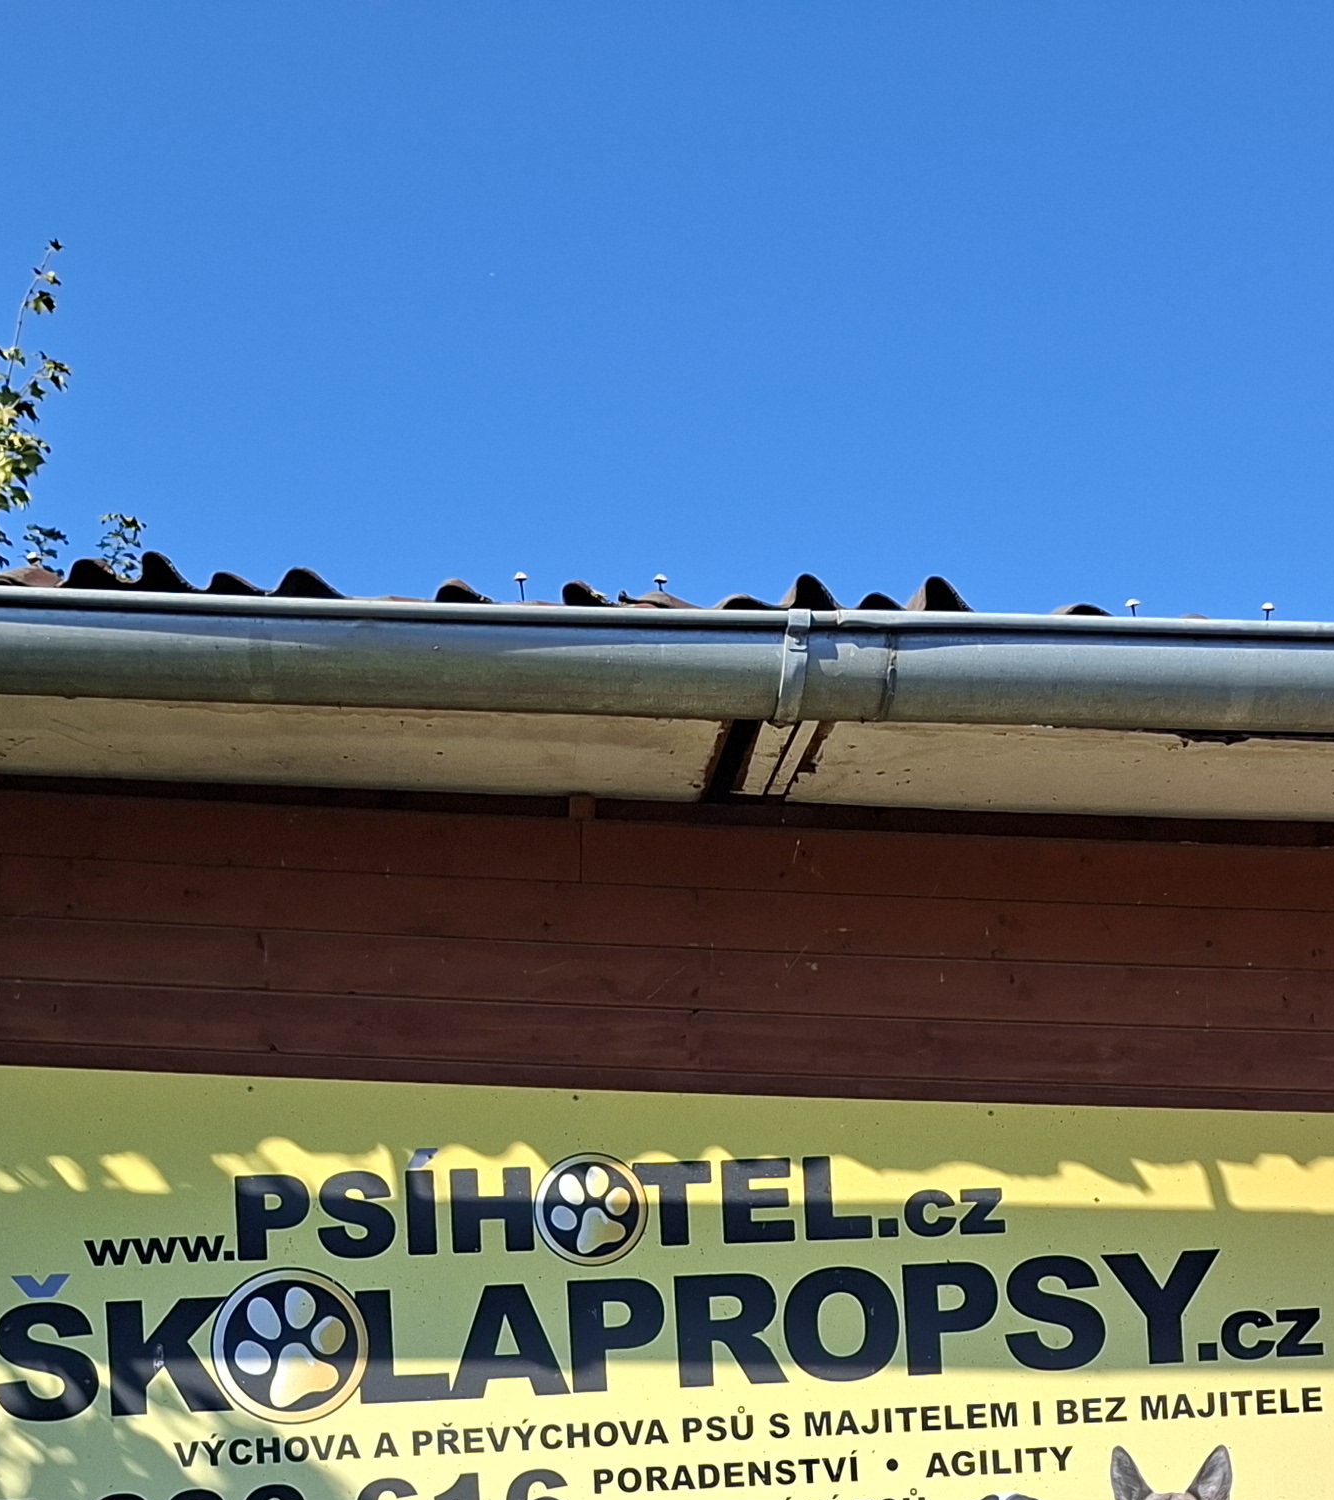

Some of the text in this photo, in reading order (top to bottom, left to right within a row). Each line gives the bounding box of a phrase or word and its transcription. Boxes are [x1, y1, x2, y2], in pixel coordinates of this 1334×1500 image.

[175, 1387, 1323, 1467] VÝCHOVA A PŘEVÝCHOVA PSŮ S MAJITELEM I BEZ MAJITELE
[593, 1446, 1073, 1494] PORADENSTVÍ AGILITY
